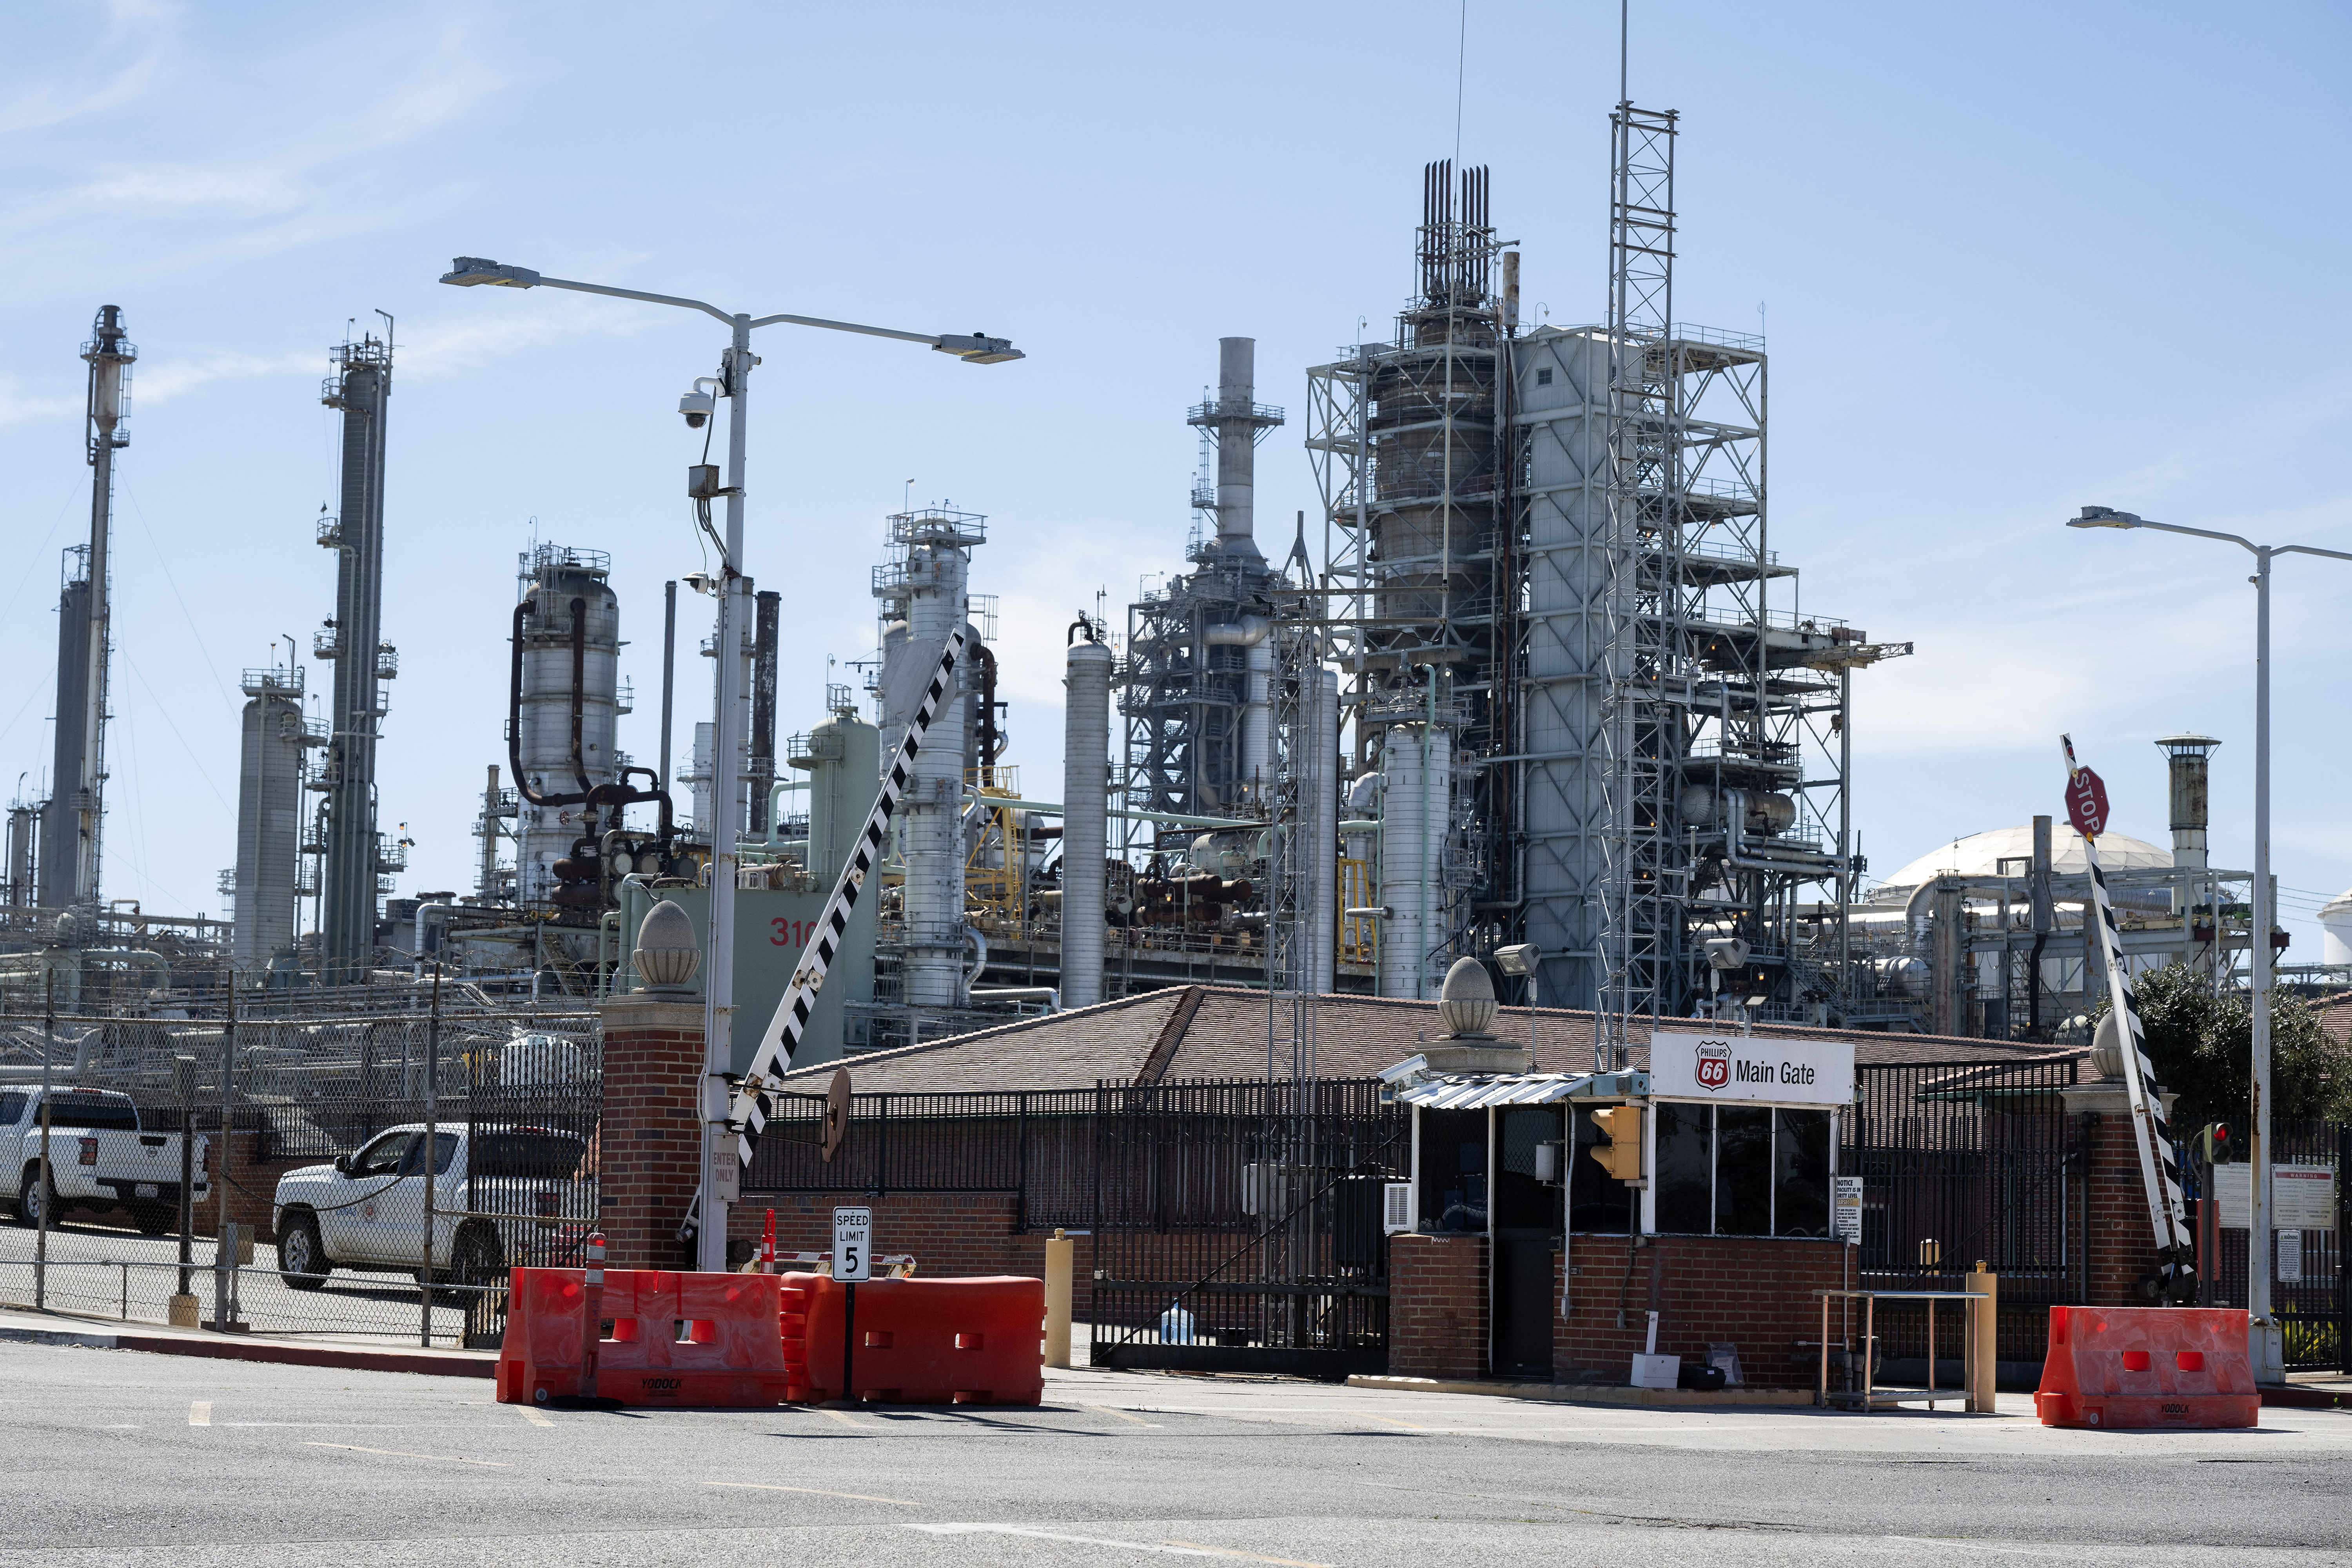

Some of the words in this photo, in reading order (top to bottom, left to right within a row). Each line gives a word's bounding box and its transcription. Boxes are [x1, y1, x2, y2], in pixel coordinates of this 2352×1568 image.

[2074, 773, 2100, 831] STOP
[1701, 1048, 1727, 1057] PHILLIPS
[1701, 1062, 1724, 1080] 66
[1736, 1060, 1774, 1083] Main
[1780, 1062, 1814, 1085] Gate
[713, 1152, 736, 1166] ENTER
[715, 1169, 734, 1182] ONLY
[837, 1216, 868, 1225] SPEED
[840, 1231, 864, 1241] LIMIT
[845, 1247, 858, 1273] 5
[642, 1378, 682, 1388] YODOCK
[2161, 1404, 2189, 1413] YODOCK
